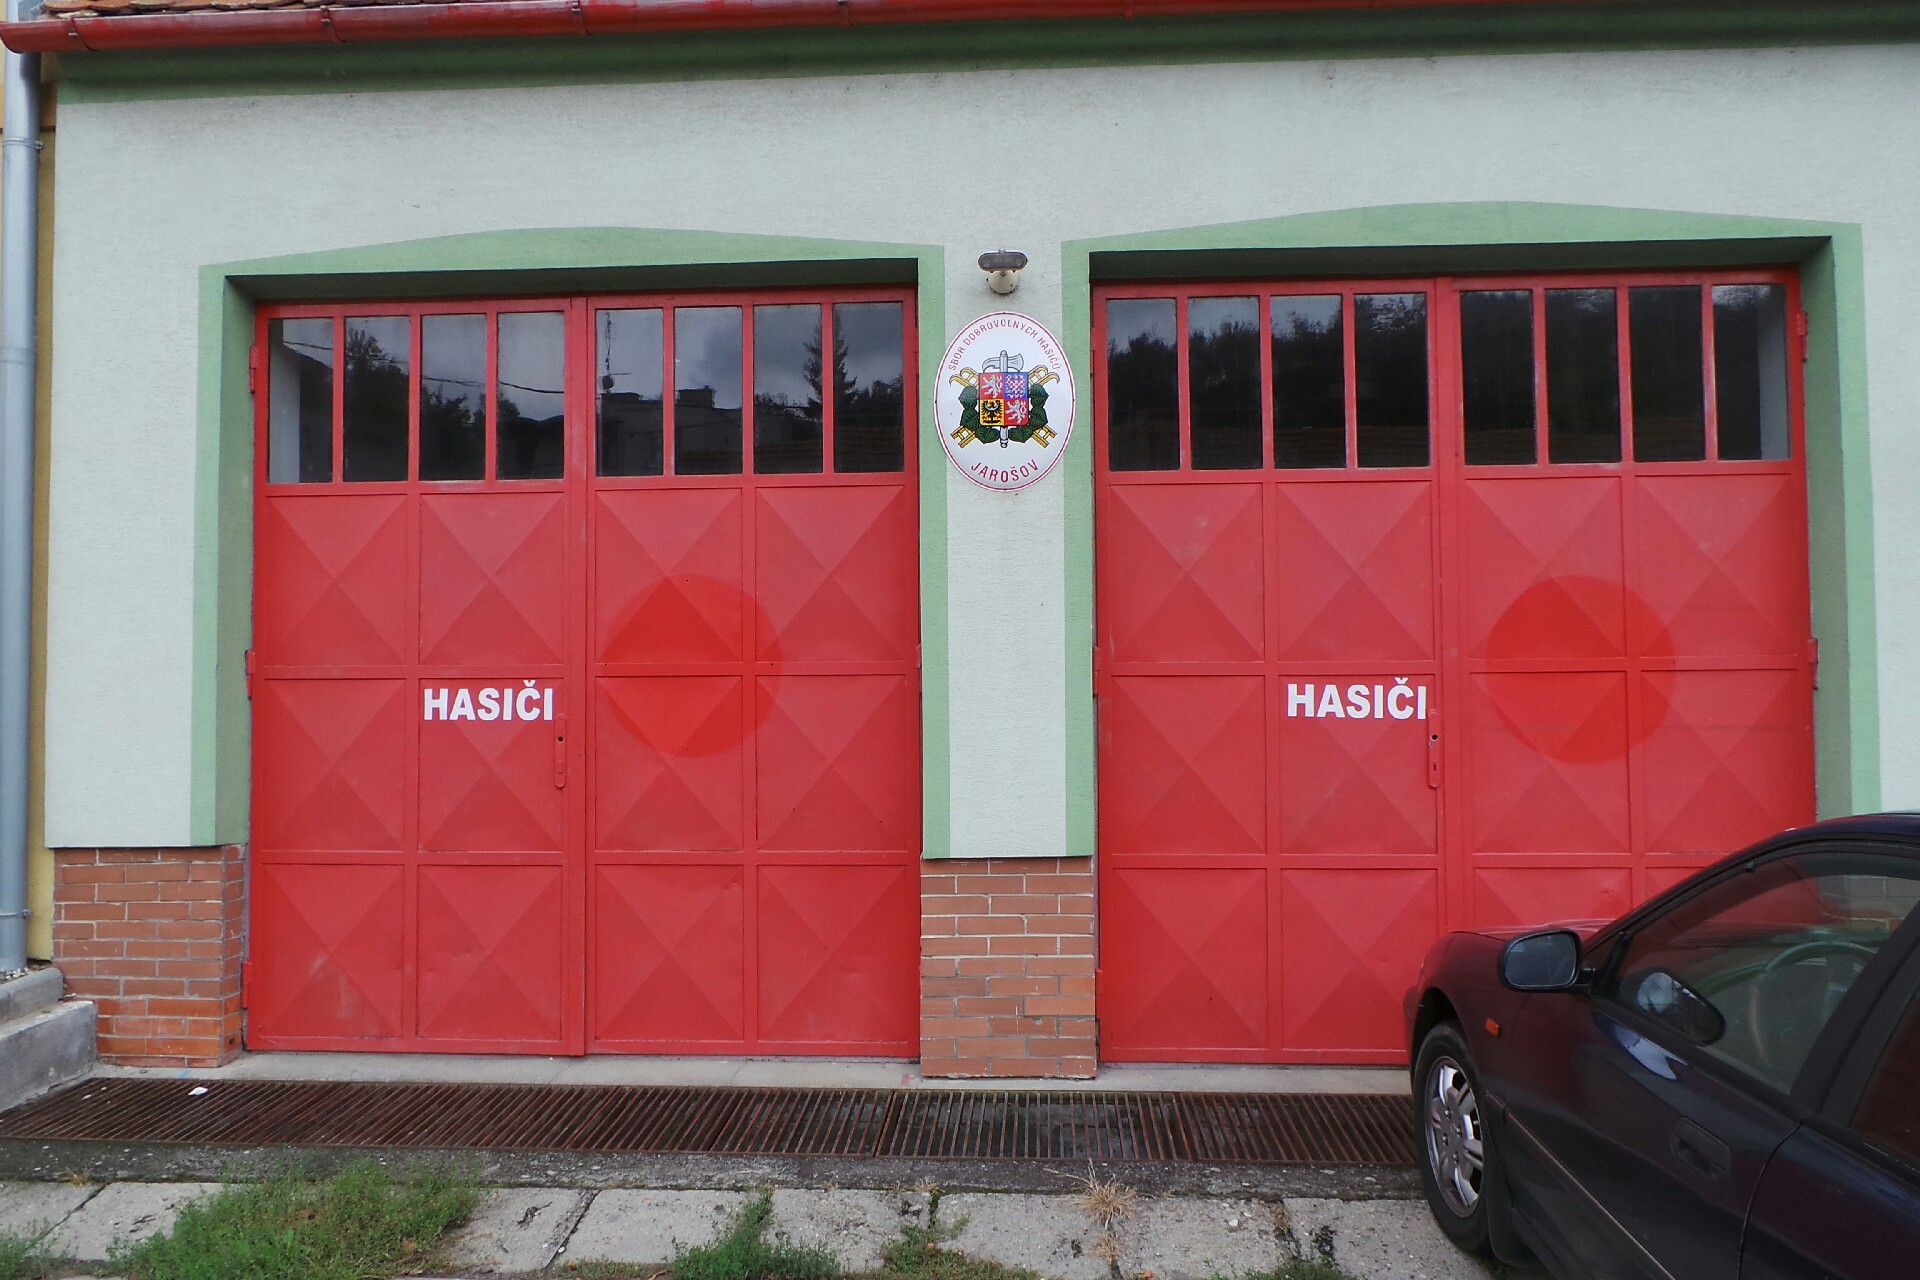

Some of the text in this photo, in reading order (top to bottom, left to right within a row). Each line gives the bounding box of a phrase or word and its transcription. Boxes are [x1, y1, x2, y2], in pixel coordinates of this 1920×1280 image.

[948, 346, 966, 371] SBOR
[970, 458, 1039, 483] JAROŠOV
[423, 679, 553, 721] HASIČI
[1287, 677, 1427, 720] HASIČI
